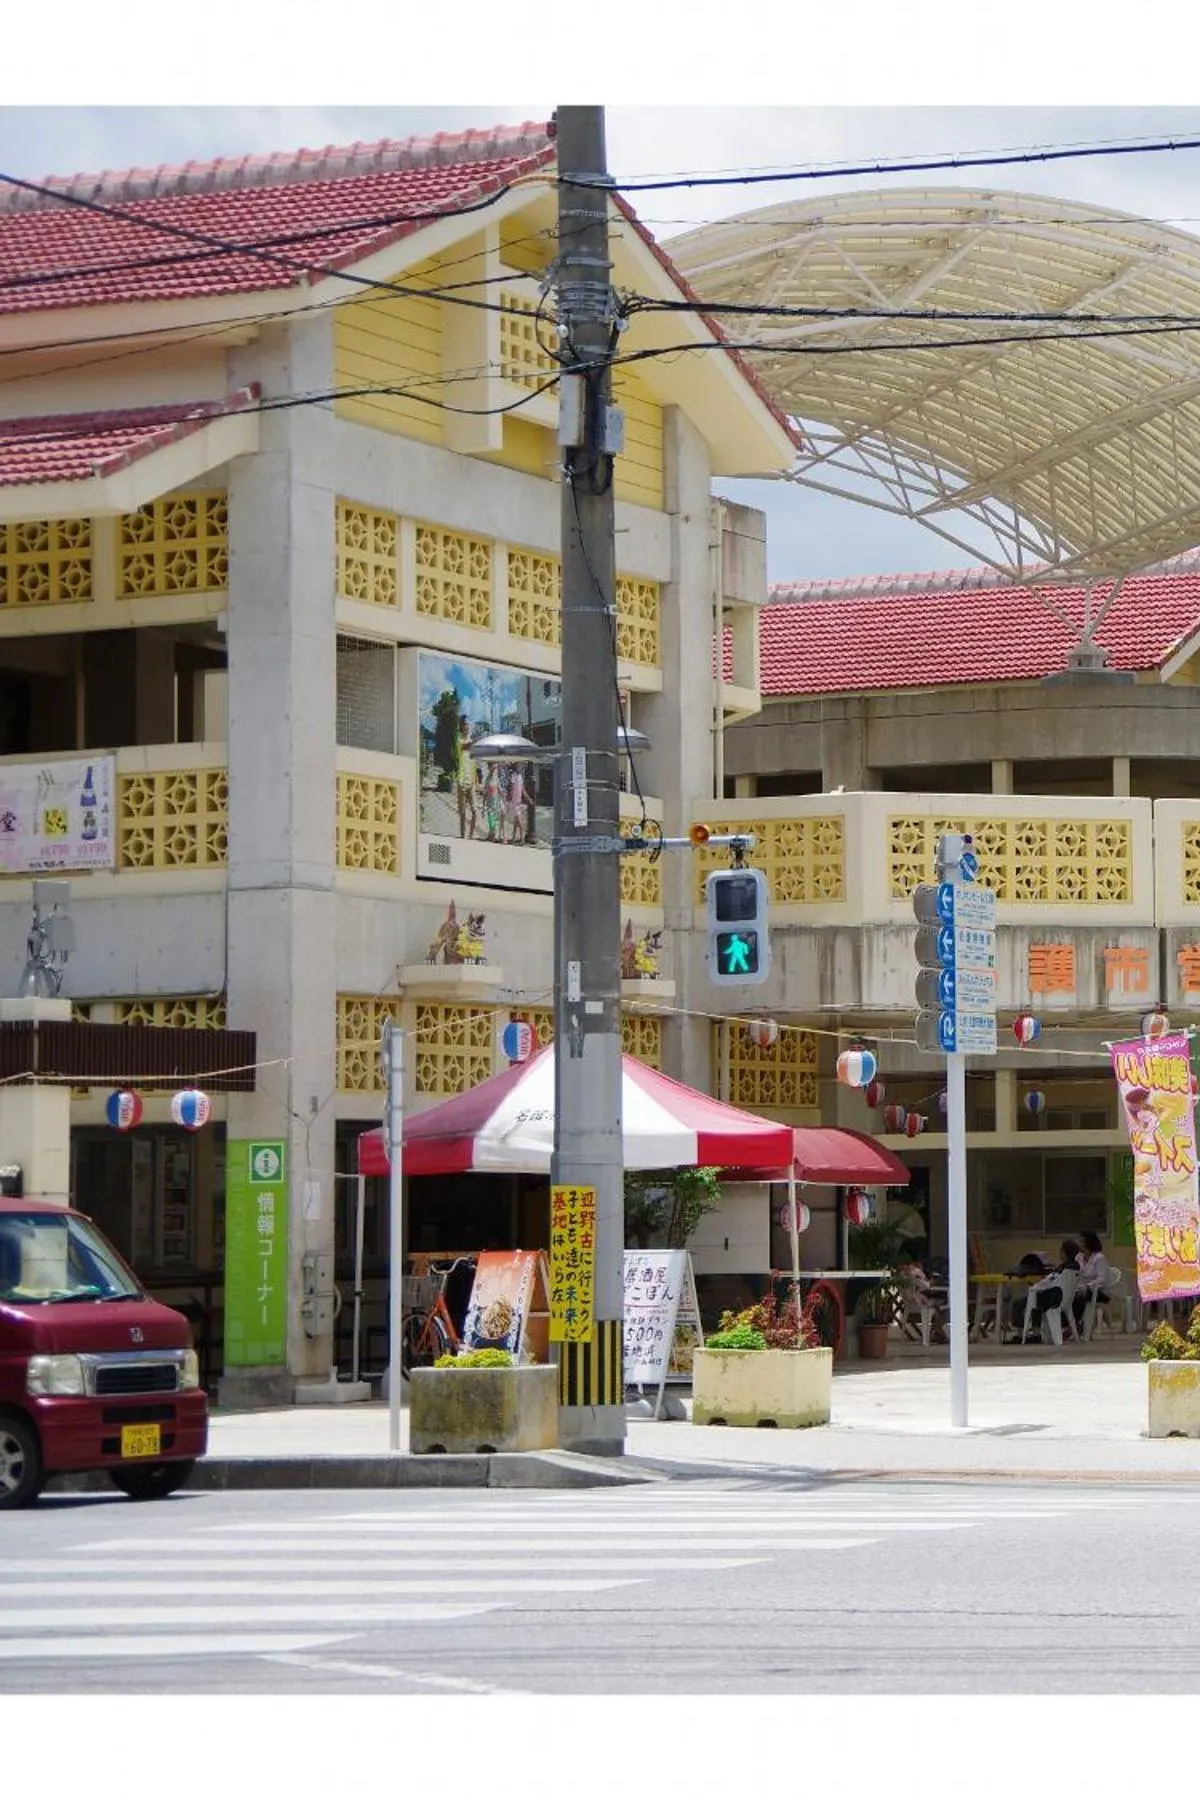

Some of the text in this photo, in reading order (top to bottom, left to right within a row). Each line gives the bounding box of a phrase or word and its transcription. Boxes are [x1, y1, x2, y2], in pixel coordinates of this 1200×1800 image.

[256, 1191, 275, 1326] 情報コーナー
[551, 1191, 567, 1320] 基地はいらない
[564, 1190, 580, 1340] 子ども達の未来に
